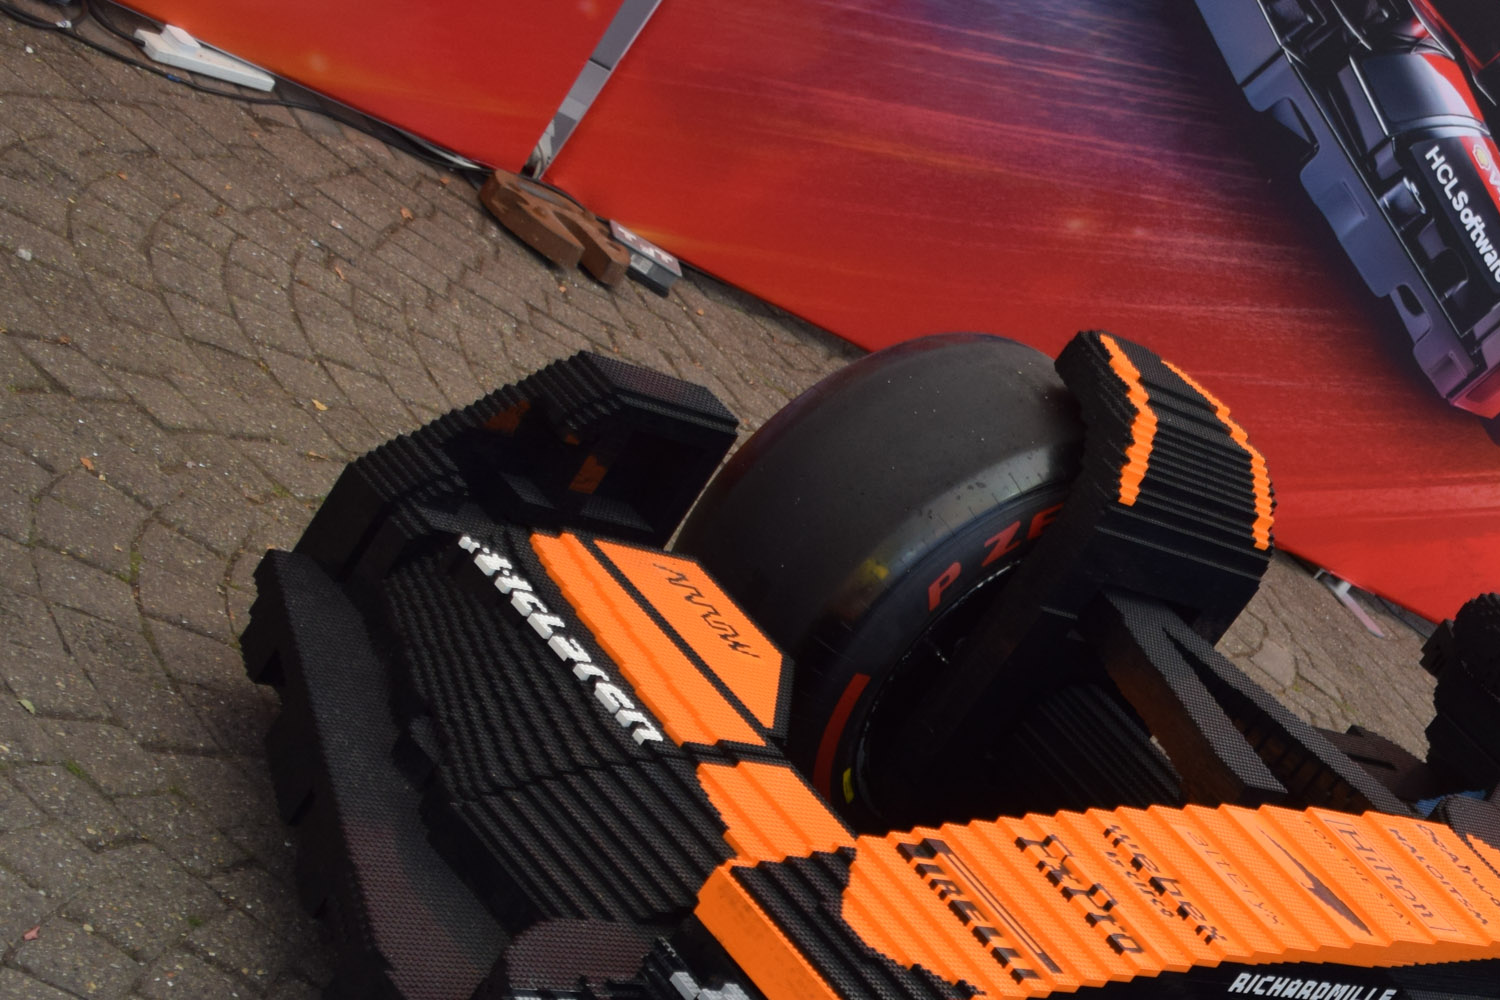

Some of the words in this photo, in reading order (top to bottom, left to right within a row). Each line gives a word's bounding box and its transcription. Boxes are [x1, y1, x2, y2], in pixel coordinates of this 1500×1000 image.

[927, 561, 962, 612] P
[896, 837, 1064, 985] PIRELLI
[1013, 833, 1145, 956] FxPro
[1338, 827, 1434, 919] Hilton
